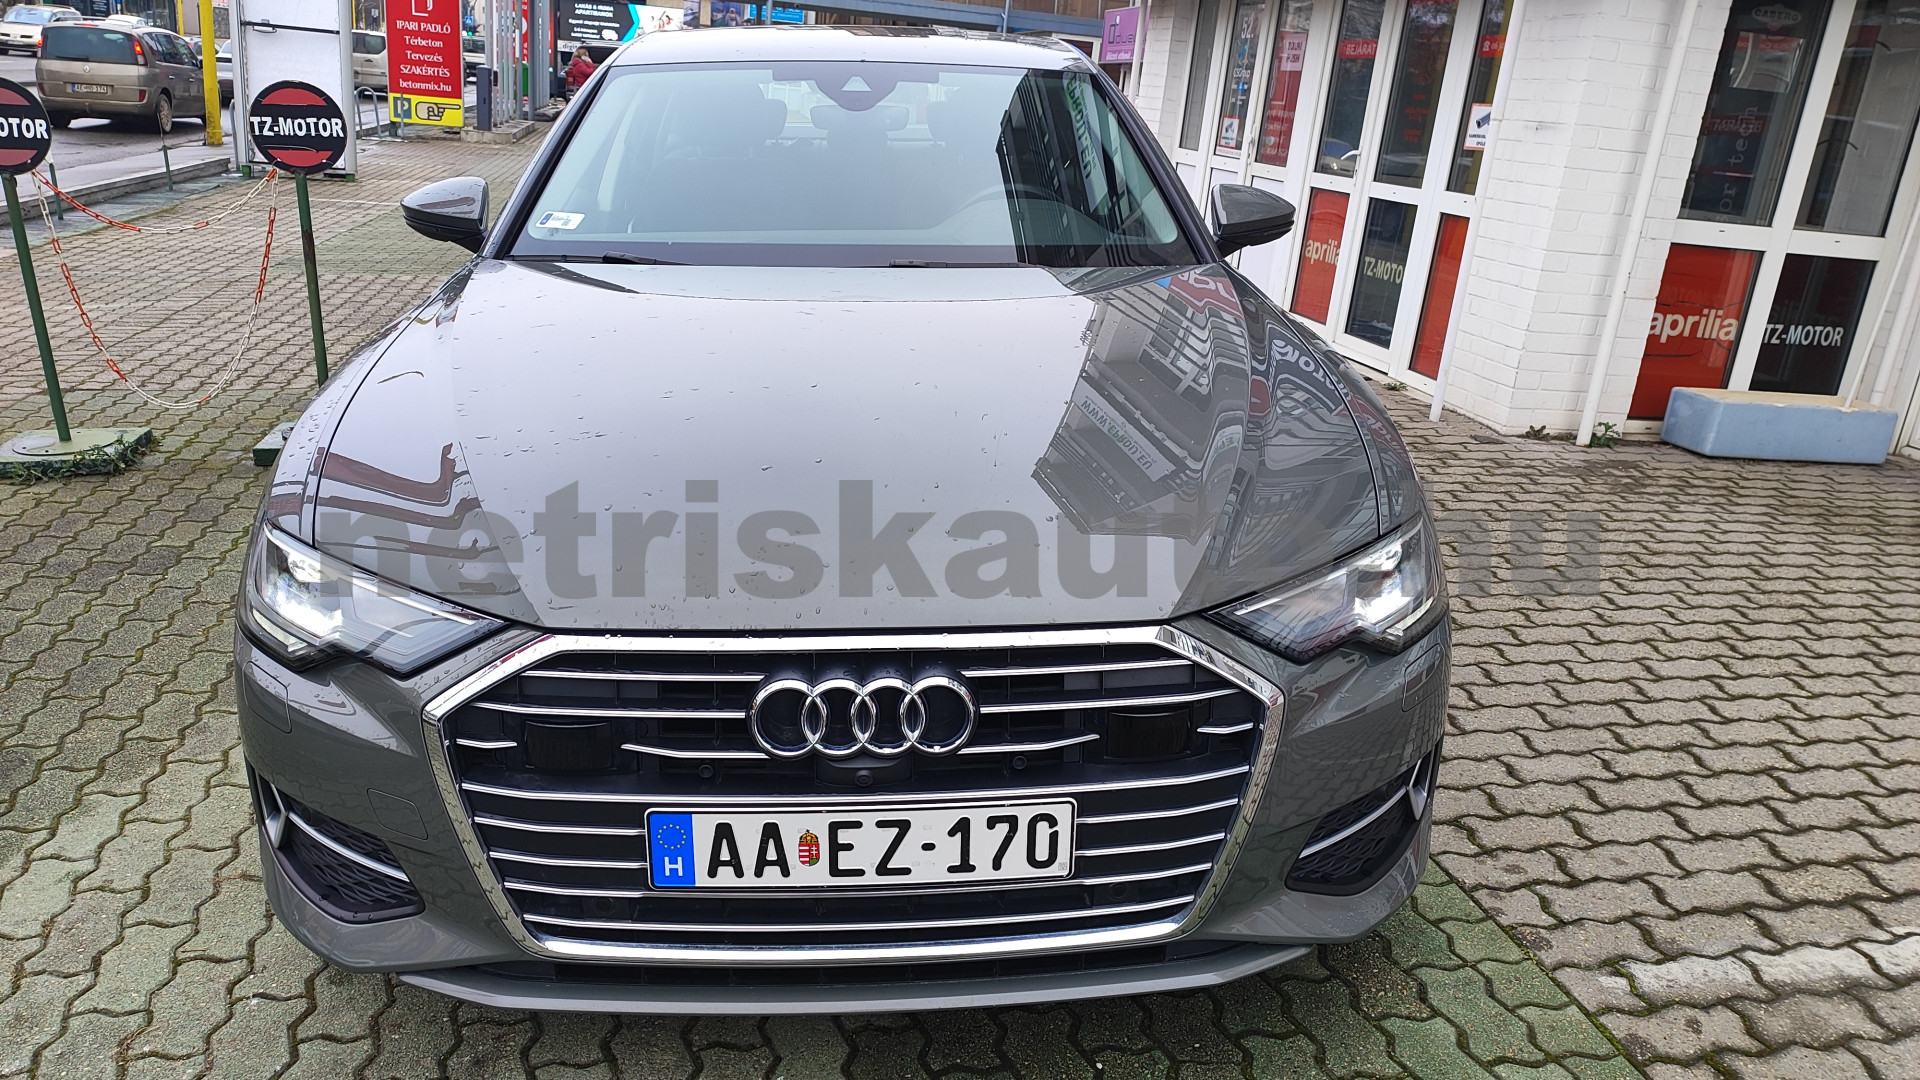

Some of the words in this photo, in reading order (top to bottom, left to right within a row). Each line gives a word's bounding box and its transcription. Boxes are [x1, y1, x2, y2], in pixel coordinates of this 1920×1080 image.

[396, 20, 418, 30] IPARI
[420, 22, 451, 34] PADLÓ
[404, 35, 443, 48] Térbeton
[405, 50, 443, 63] Tervezés
[400, 64, 450, 78] SZAKÉRTÉS
[400, 78, 452, 92] betonmix.hu
[250, 116, 345, 138] TZ-MOTOR
[1650, 309, 1739, 344] aprilia
[1763, 323, 1845, 347] TZ-MOTOR
[707, 820, 791, 879] AA
[828, 812, 1059, 878] EZ-170
[664, 856, 683, 877] H
